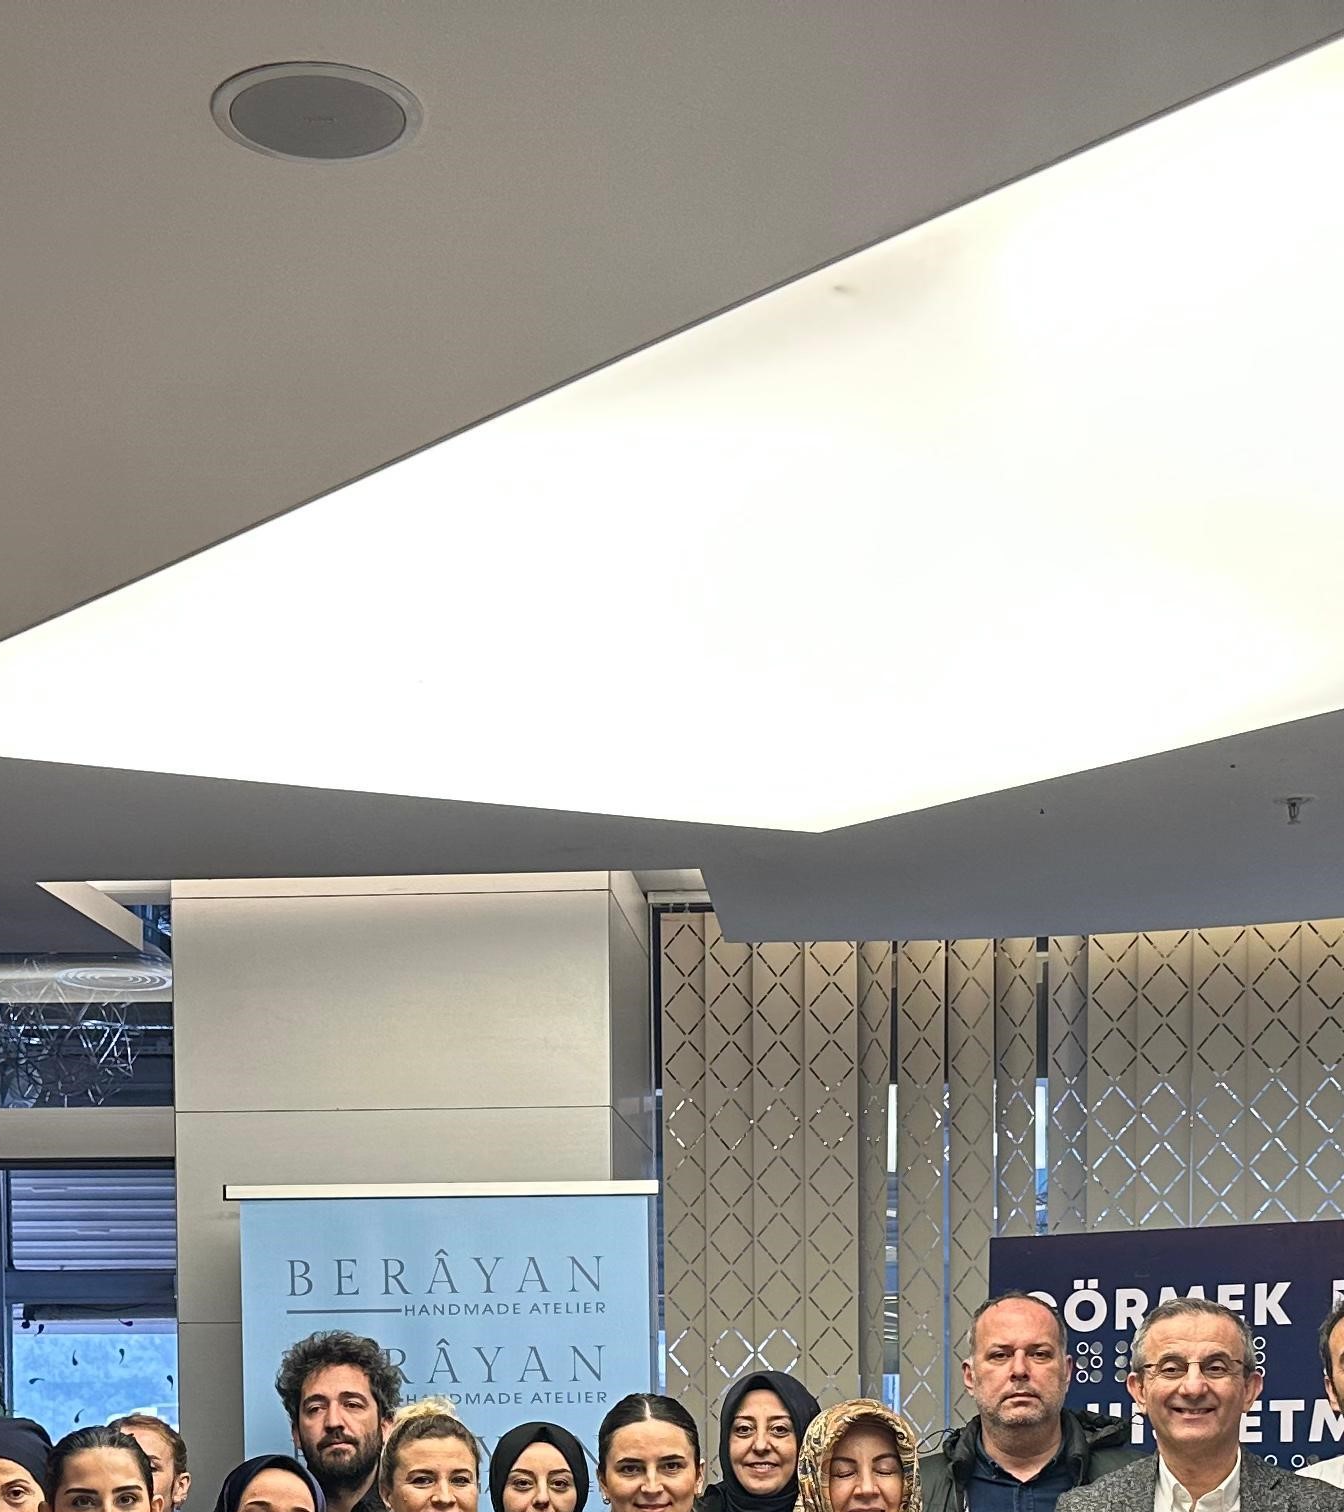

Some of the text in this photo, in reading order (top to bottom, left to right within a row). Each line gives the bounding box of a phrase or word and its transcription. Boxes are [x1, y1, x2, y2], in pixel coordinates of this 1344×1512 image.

[287, 1248, 604, 1297] BERÂYAN
[405, 1301, 606, 1317] HANDMADE ATELIER
[386, 1338, 606, 1385] RÂYAN
[406, 1390, 607, 1405] HDMADE ATELIER
